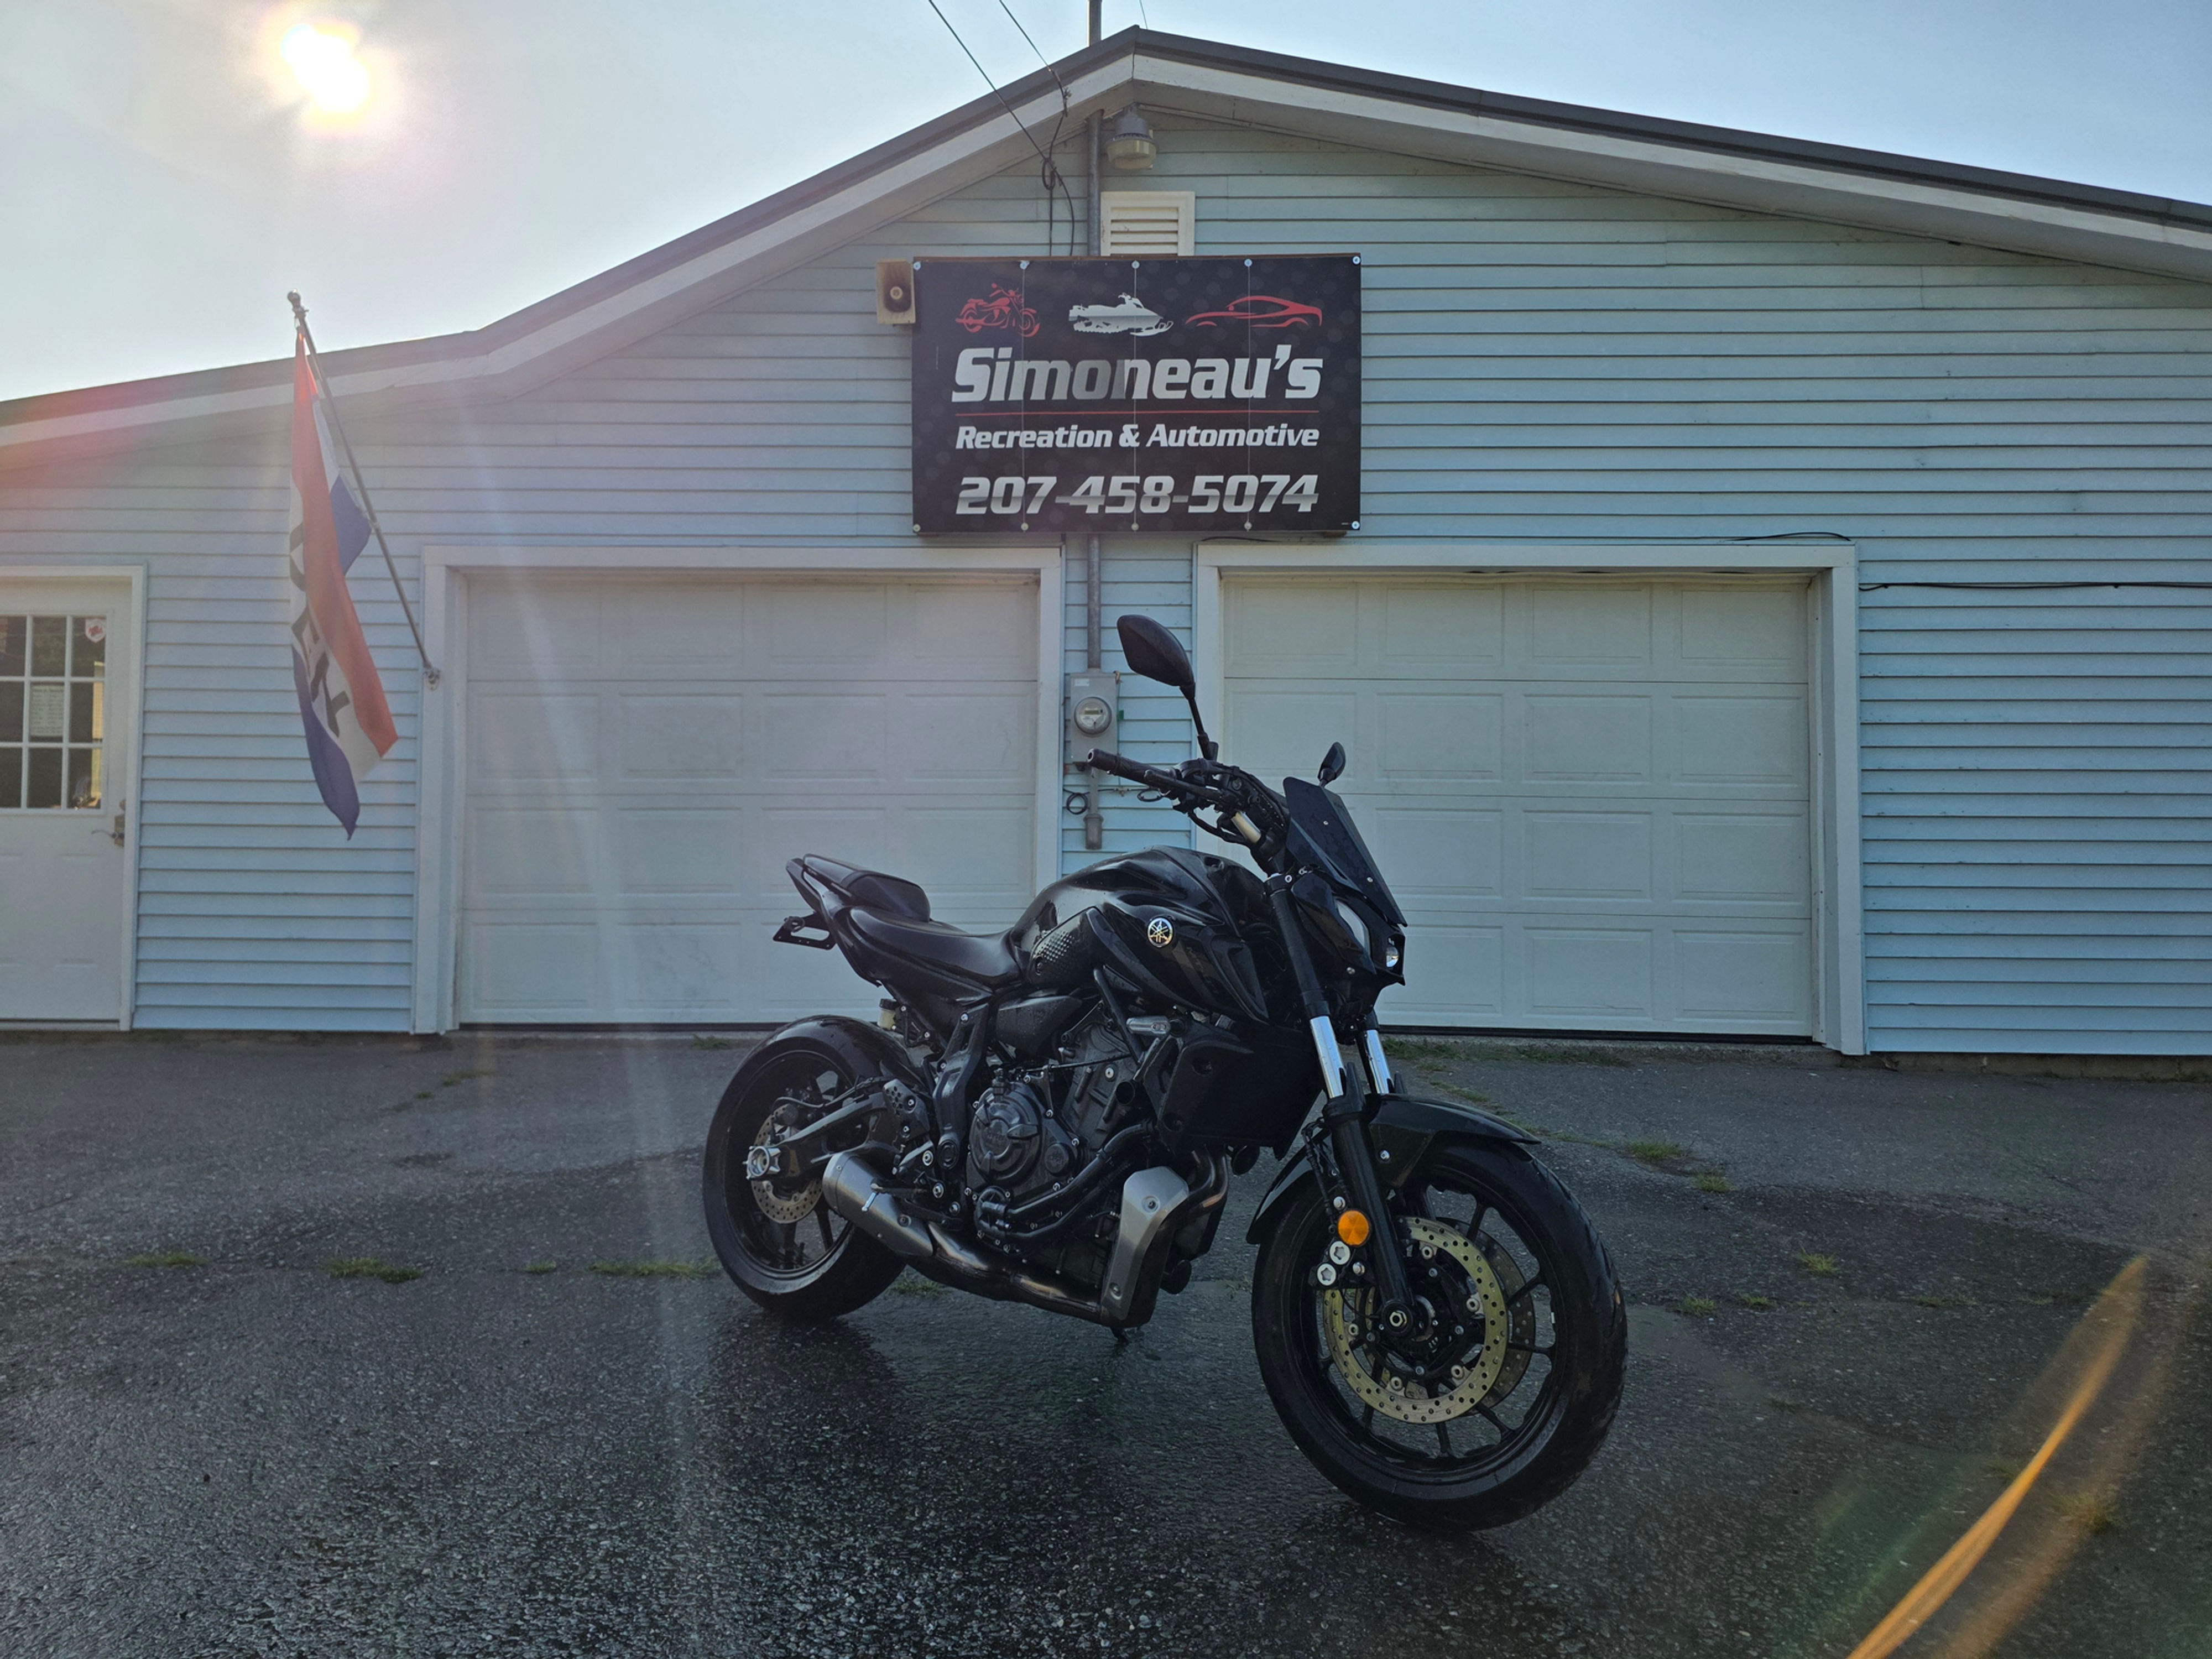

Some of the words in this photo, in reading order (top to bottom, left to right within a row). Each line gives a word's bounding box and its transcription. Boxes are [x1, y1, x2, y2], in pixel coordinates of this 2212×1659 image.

[952, 345, 1323, 403] Simoneau's
[956, 425, 1112, 449] Recreation
[1119, 424, 1140, 448] &
[1146, 423, 1319, 447] Automotive
[956, 475, 1319, 514] 207-458-5074
